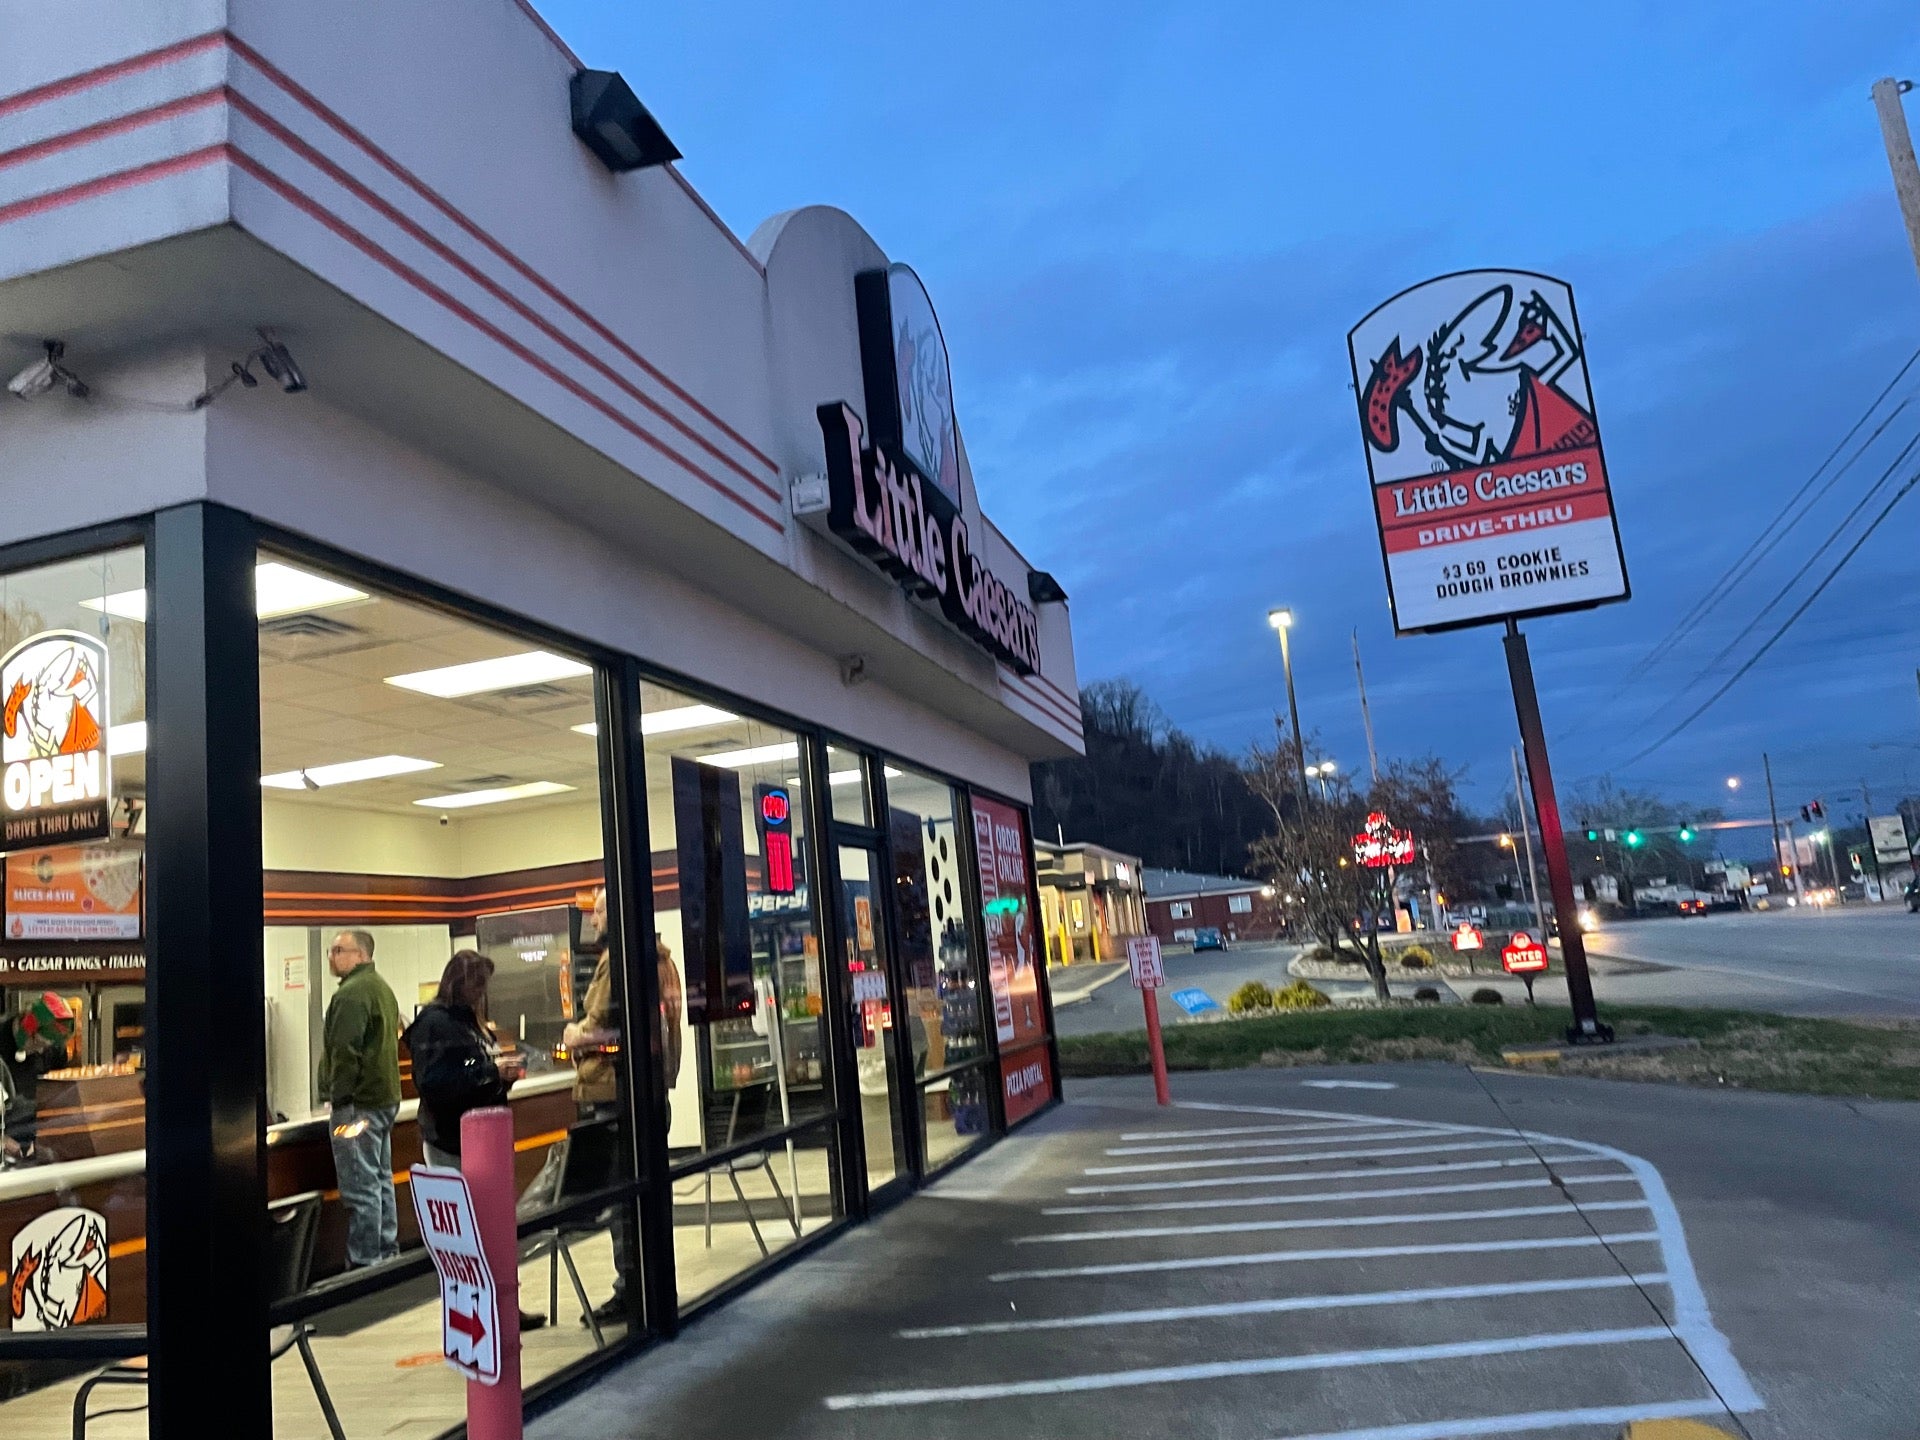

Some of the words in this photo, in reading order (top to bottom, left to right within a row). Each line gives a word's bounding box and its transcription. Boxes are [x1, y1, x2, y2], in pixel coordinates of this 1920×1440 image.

[1392, 480, 1469, 518] Little
[1474, 461, 1588, 502] Caesars
[841, 403, 947, 595] Little
[951, 514, 1040, 676] Caesars
[1418, 504, 1574, 546] DRIVE-THRU
[1497, 546, 1562, 571] COOKIE
[1436, 576, 1495, 599] DOUGH
[1499, 560, 1589, 588] BROWNIES
[4, 749, 100, 811] OPEN
[763, 795, 788, 819] OPEN
[5, 820, 38, 840] DRIVE
[40, 814, 70, 835] THRU
[71, 810, 100, 830] ONLY
[995, 824, 1022, 856] ORDER
[998, 852, 1026, 885] ONLINE
[748, 886, 808, 914] PEPSI
[17, 956, 63, 972] CAESAR
[65, 955, 102, 971] WINGS
[108, 953, 146, 969] ITALIAN
[1505, 950, 1542, 962] ENTER
[1005, 1071, 1024, 1099] PIZZA
[426, 1198, 462, 1238] EXIT
[434, 1246, 486, 1291] RIGHT
